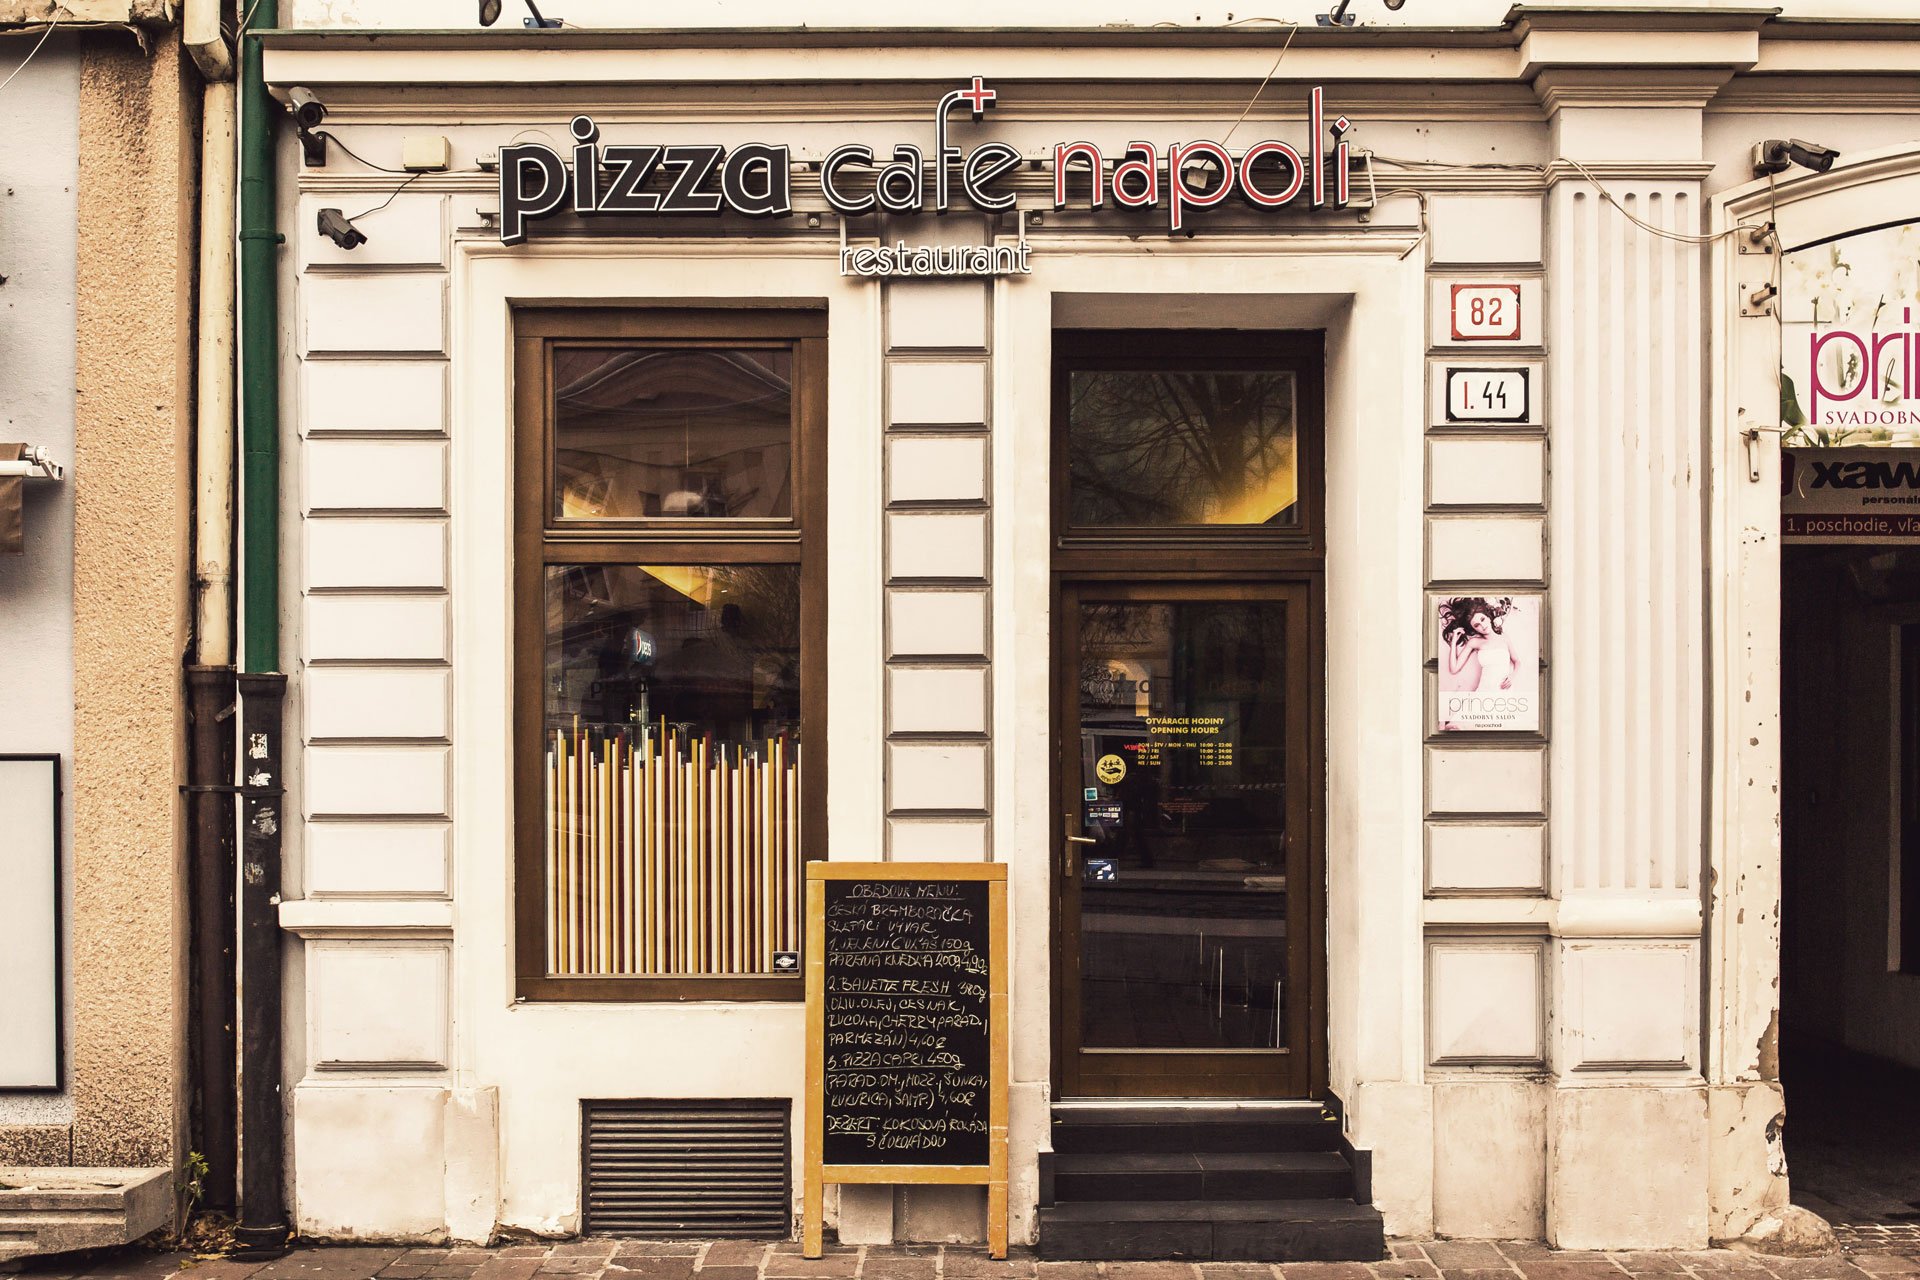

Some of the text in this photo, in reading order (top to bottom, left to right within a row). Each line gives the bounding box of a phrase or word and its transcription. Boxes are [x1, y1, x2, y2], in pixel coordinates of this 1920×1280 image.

[498, 114, 793, 247] pizza
[1053, 86, 1352, 237] napoli
[839, 240, 1033, 277] restaurant
[1470, 297, 1503, 326] 82
[1482, 381, 1507, 409] 44
[1787, 518, 1801, 532] 1.
[1806, 517, 1893, 535] poschodie,
[1448, 692, 1529, 716] princess
[1145, 716, 1224, 725] OTVÁRACIE HODINY
[1150, 726, 1219, 734] OPENING HOURS
[902, 979, 951, 994] FRESH
